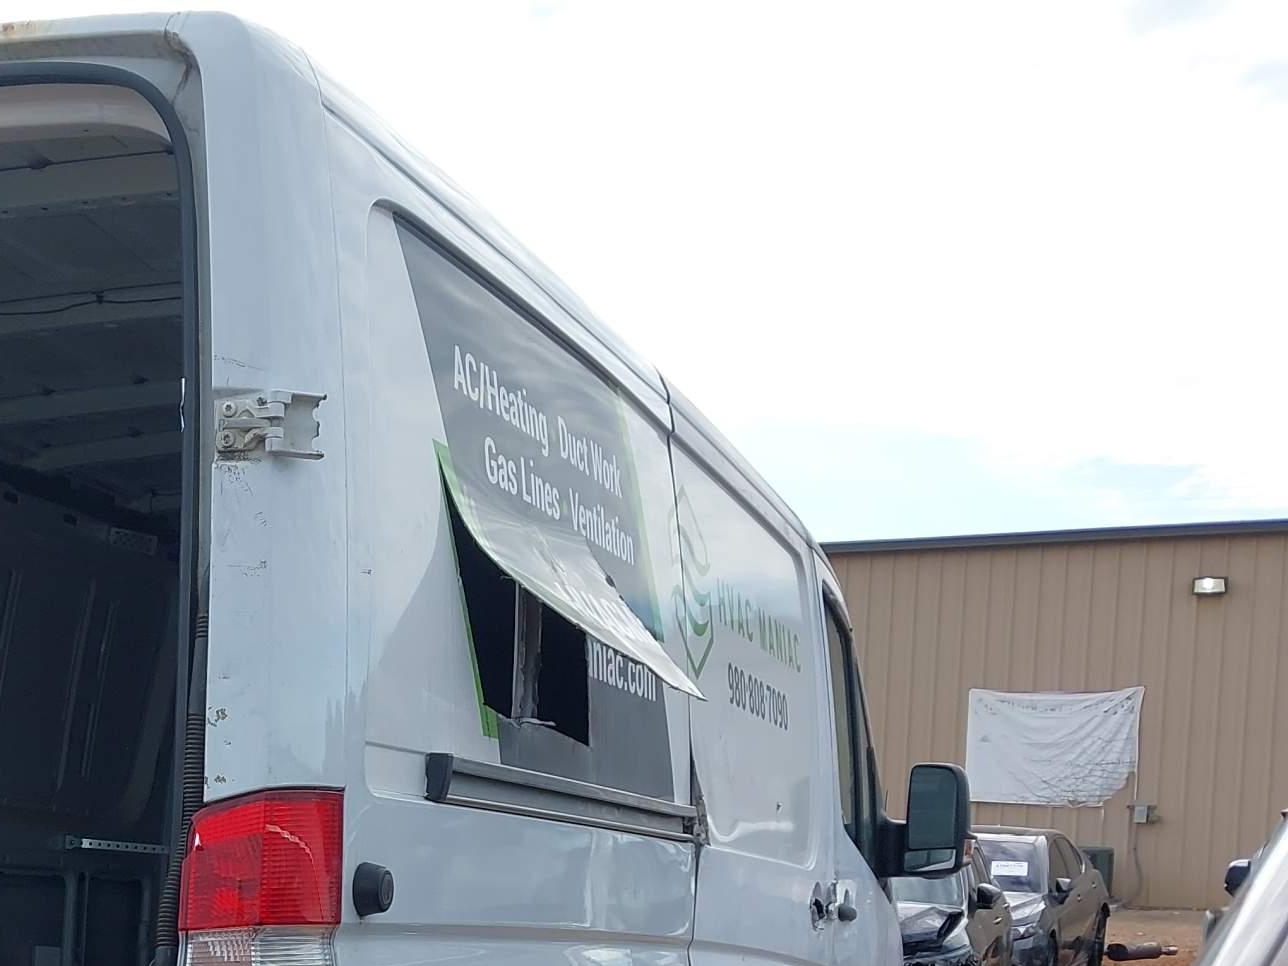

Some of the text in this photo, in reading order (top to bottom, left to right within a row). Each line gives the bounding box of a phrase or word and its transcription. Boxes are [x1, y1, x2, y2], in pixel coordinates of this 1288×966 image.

[454, 344, 622, 499] AC/Heating Duct Work
[484, 436, 635, 566] Gas Lines Ventilation
[716, 575, 753, 643] HVAC
[758, 606, 801, 673] MANIAC
